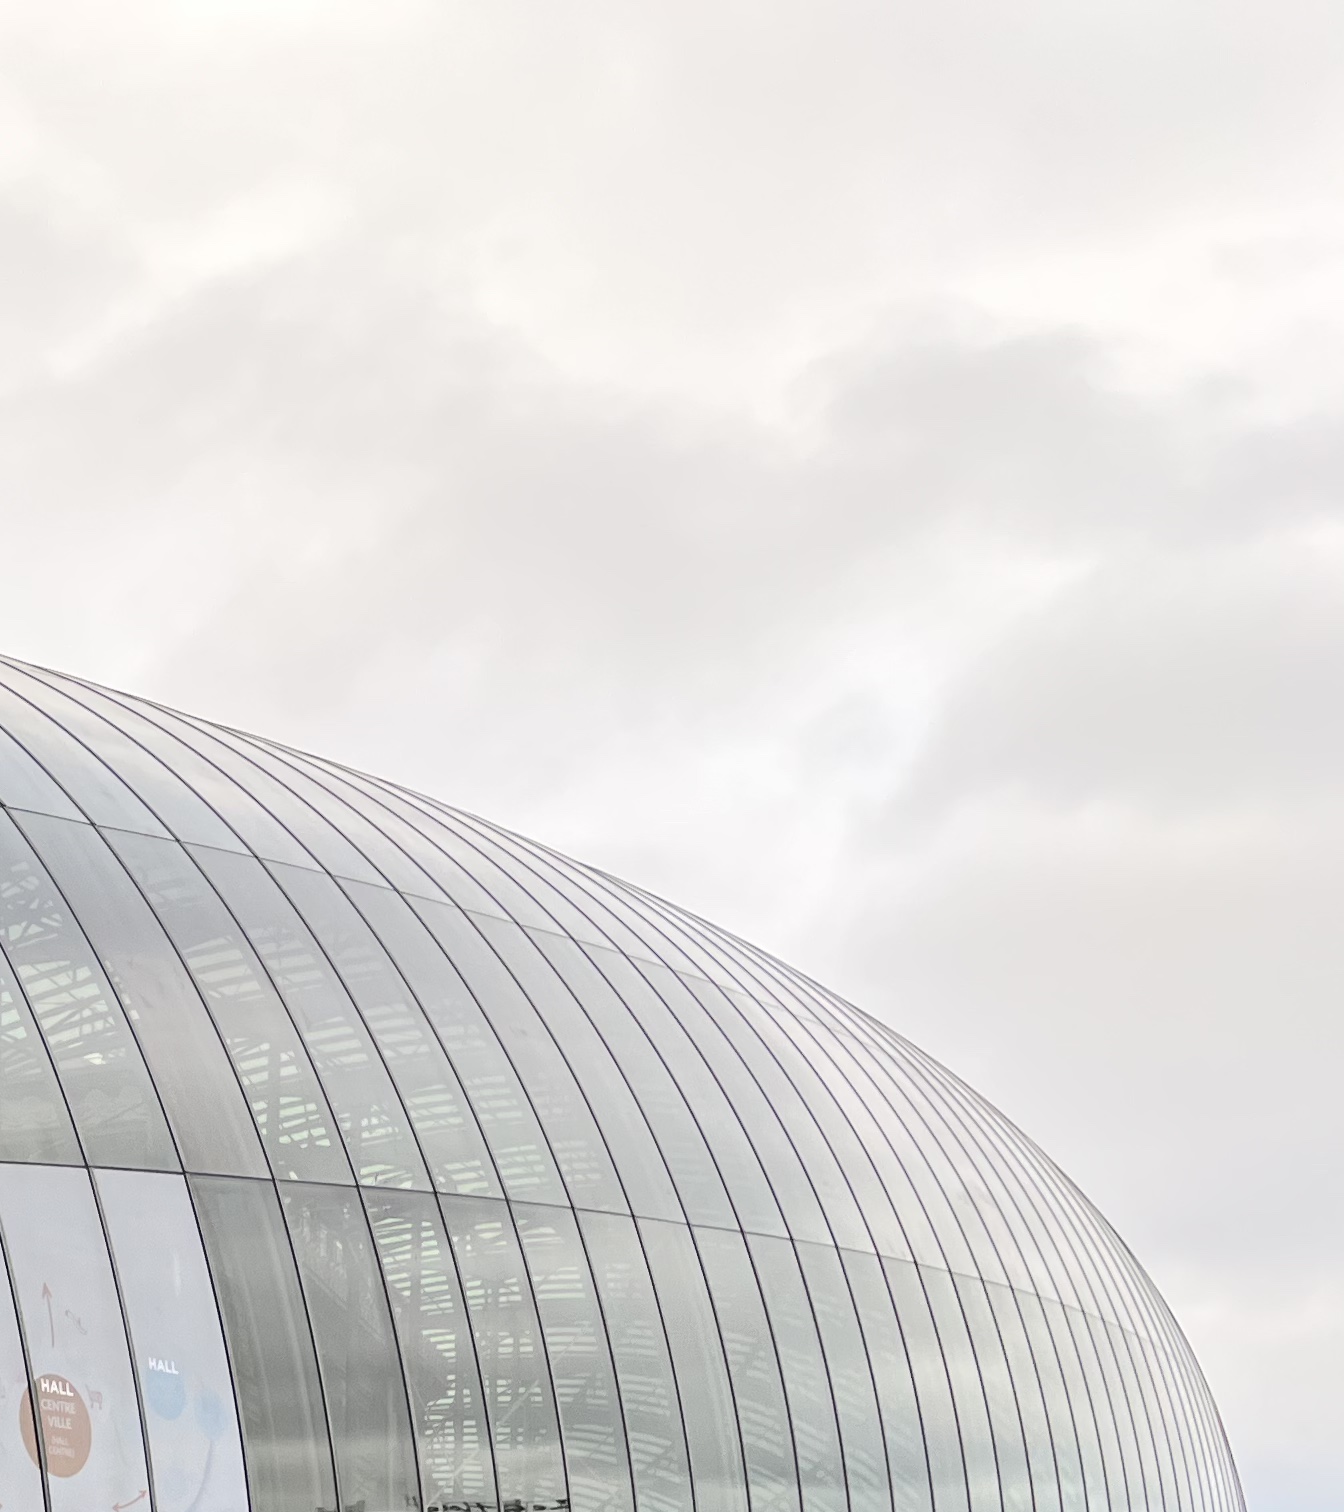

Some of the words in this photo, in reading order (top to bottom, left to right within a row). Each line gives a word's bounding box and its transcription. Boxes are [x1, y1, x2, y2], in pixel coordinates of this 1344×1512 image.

[148, 1357, 180, 1375] HALL
[40, 1378, 75, 1397] HALL
[40, 1398, 77, 1415] CENTRE
[47, 1415, 74, 1430] VILLE
